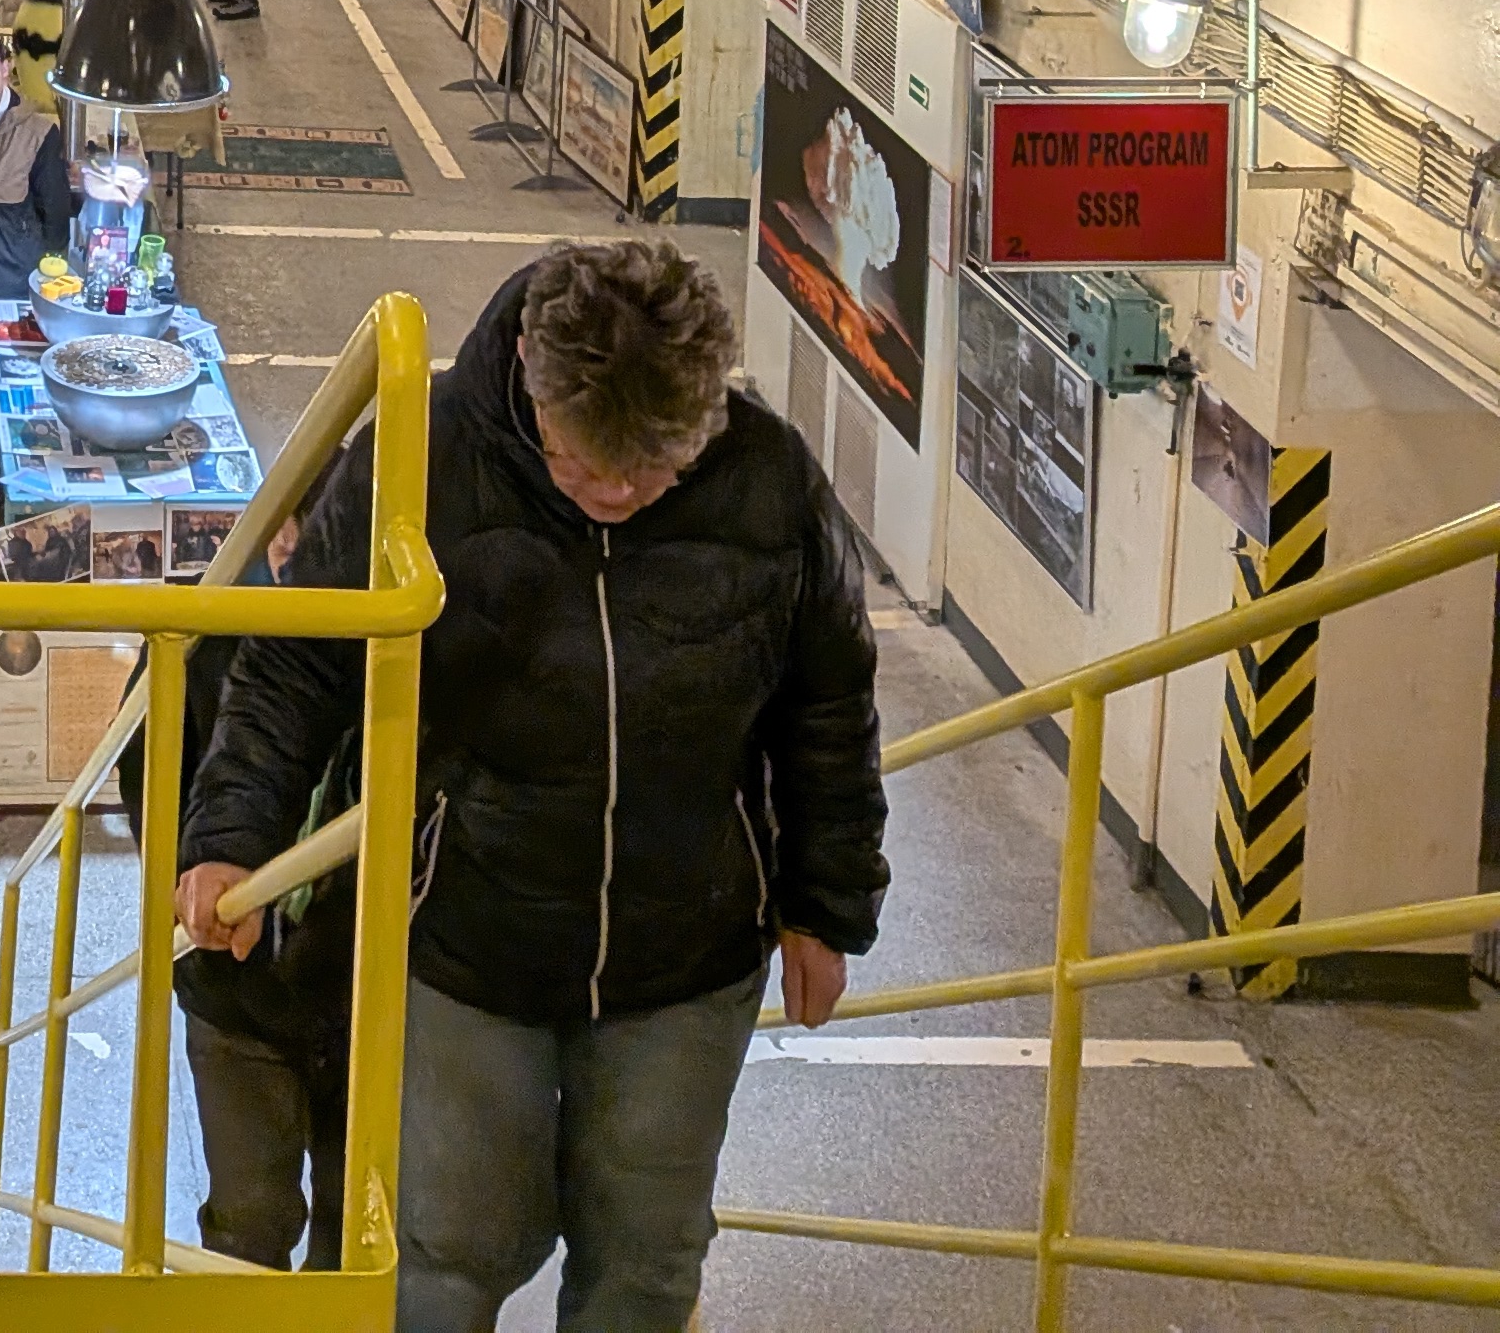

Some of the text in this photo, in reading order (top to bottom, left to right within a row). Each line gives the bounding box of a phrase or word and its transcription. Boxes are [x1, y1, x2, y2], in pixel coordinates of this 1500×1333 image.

[1011, 131, 1209, 167] ATOM PROGRAM
[1077, 191, 1141, 227] SSSR
[1006, 235, 1031, 258] 2.
